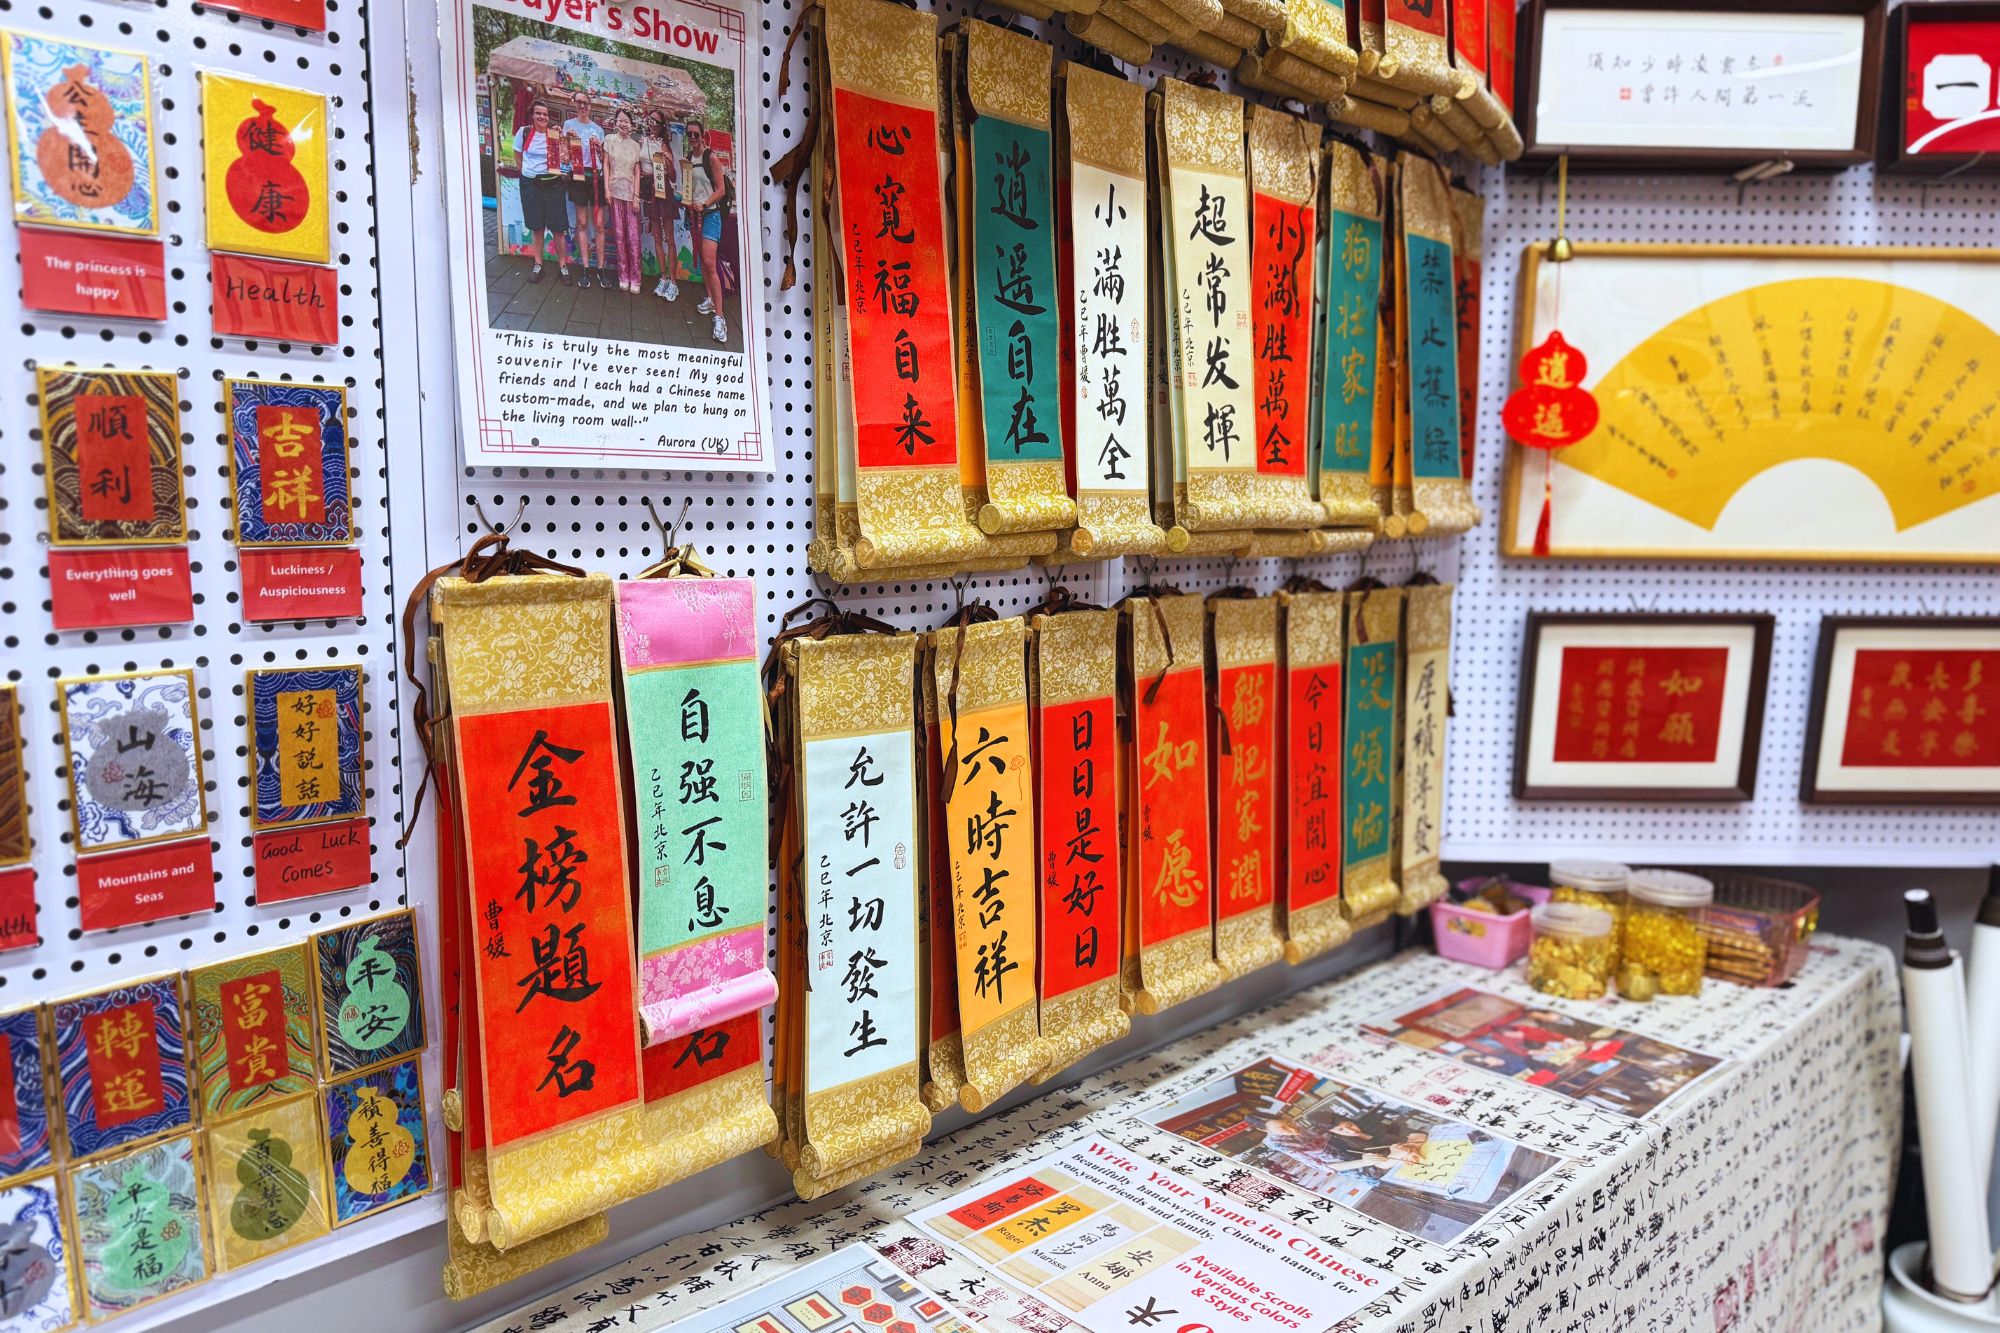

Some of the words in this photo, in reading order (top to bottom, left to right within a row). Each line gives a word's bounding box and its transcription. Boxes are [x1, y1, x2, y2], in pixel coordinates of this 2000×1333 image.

[504, 0, 622, 30] yer's
[633, 6, 719, 54] Show
[243, 119, 296, 224] 健康
[45, 256, 72, 272] The
[75, 259, 133, 281] princess
[136, 264, 147, 278] is
[76, 282, 120, 302] happy
[224, 276, 326, 310] Health
[851, 223, 867, 315] 乙巳年北京
[497, 355, 563, 370] souvenir
[572, 358, 598, 373] I've
[607, 363, 638, 376] ever
[646, 365, 681, 378] seen!
[689, 369, 709, 384] My
[715, 372, 744, 385] good
[542, 339, 554, 350] is
[563, 340, 598, 357] truly
[607, 343, 630, 357] the
[637, 348, 670, 360] most
[677, 352, 744, 368] meaningful
[498, 371, 546, 388] friends
[553, 376, 576, 389] and
[583, 376, 588, 390] I
[594, 379, 622, 393] each
[629, 380, 650, 394] had
[656, 386, 663, 395] a
[669, 383, 712, 398] Chinese
[717, 391, 746, 401] name
[500, 391, 595, 409] custom-made,
[603, 397, 625, 410] and
[631, 401, 648, 412] we
[653, 400, 678, 414] plan
[684, 402, 697, 414] to
[703, 403, 729, 418] hung
[734, 408, 747, 418] on
[502, 409, 526, 422] the
[532, 410, 565, 427] living
[572, 416, 604, 426] room
[657, 434, 696, 448] Aurora
[701, 436, 730, 452] (UK)
[88, 404, 134, 506] 順利
[262, 410, 322, 520] 吉祥
[66, 568, 139, 584] Everything
[142, 567, 174, 581] goes
[109, 588, 137, 601] well
[259, 584, 347, 600] Auspiciousness
[270, 563, 325, 577] Luckiness
[116, 724, 169, 807] 山海
[1303, 672, 1331, 886] 今日宜開心
[650, 768, 669, 861] 乙巳年北京
[678, 687, 730, 933] 自强不息
[1142, 720, 1204, 909] 如愿
[261, 837, 305, 862] Good
[320, 825, 362, 848] Luck
[961, 727, 1019, 1005] 六時吉祥
[1061, 709, 1105, 970] 日日是好日
[98, 866, 169, 890] Mountains
[170, 863, 196, 878] and
[135, 890, 165, 904] Seas
[281, 859, 335, 885] Comes
[817, 854, 834, 947] 乙巳年北京
[506, 729, 604, 1099] 金榜題名
[839, 746, 889, 1058] 允許一切發生
[351, 956, 400, 1042] 平安
[92, 1009, 157, 1114] 轉運
[231, 982, 278, 1085] 富貴
[116, 1179, 164, 1283] 平安是福
[961, 1207, 988, 1225] Louis
[996, 1226, 1025, 1246] Roger
[1071, 1152, 1134, 1187] Beautifully
[1136, 1182, 1217, 1227] hand-written
[1222, 1225, 1275, 1255] Chinese
[1280, 1253, 1328, 1281] names
[1332, 1280, 1358, 1296] for
[1087, 1141, 1139, 1174] Write
[1147, 1170, 1195, 1198] Your
[1196, 1195, 1258, 1228] Name
[1258, 1222, 1283, 1240] in
[1287, 1237, 1380, 1288] Chinese
[1105, 1180, 1147, 1207] friends
[1147, 1203, 1173, 1219] and
[1171, 1213, 1216, 1241] family.
[1029, 1247, 1068, 1271] Marissa
[1077, 1269, 1112, 1292] Anna
[1190, 1254, 1261, 1296] Available
[1259, 1289, 1314, 1320] Scrolls
[1175, 1261, 1193, 1275] in
[1192, 1270, 1249, 1306] Various
[1250, 1300, 1302, 1330] Colors
[1190, 1286, 1206, 1299] &
[1203, 1293, 1253, 1323] Styles
